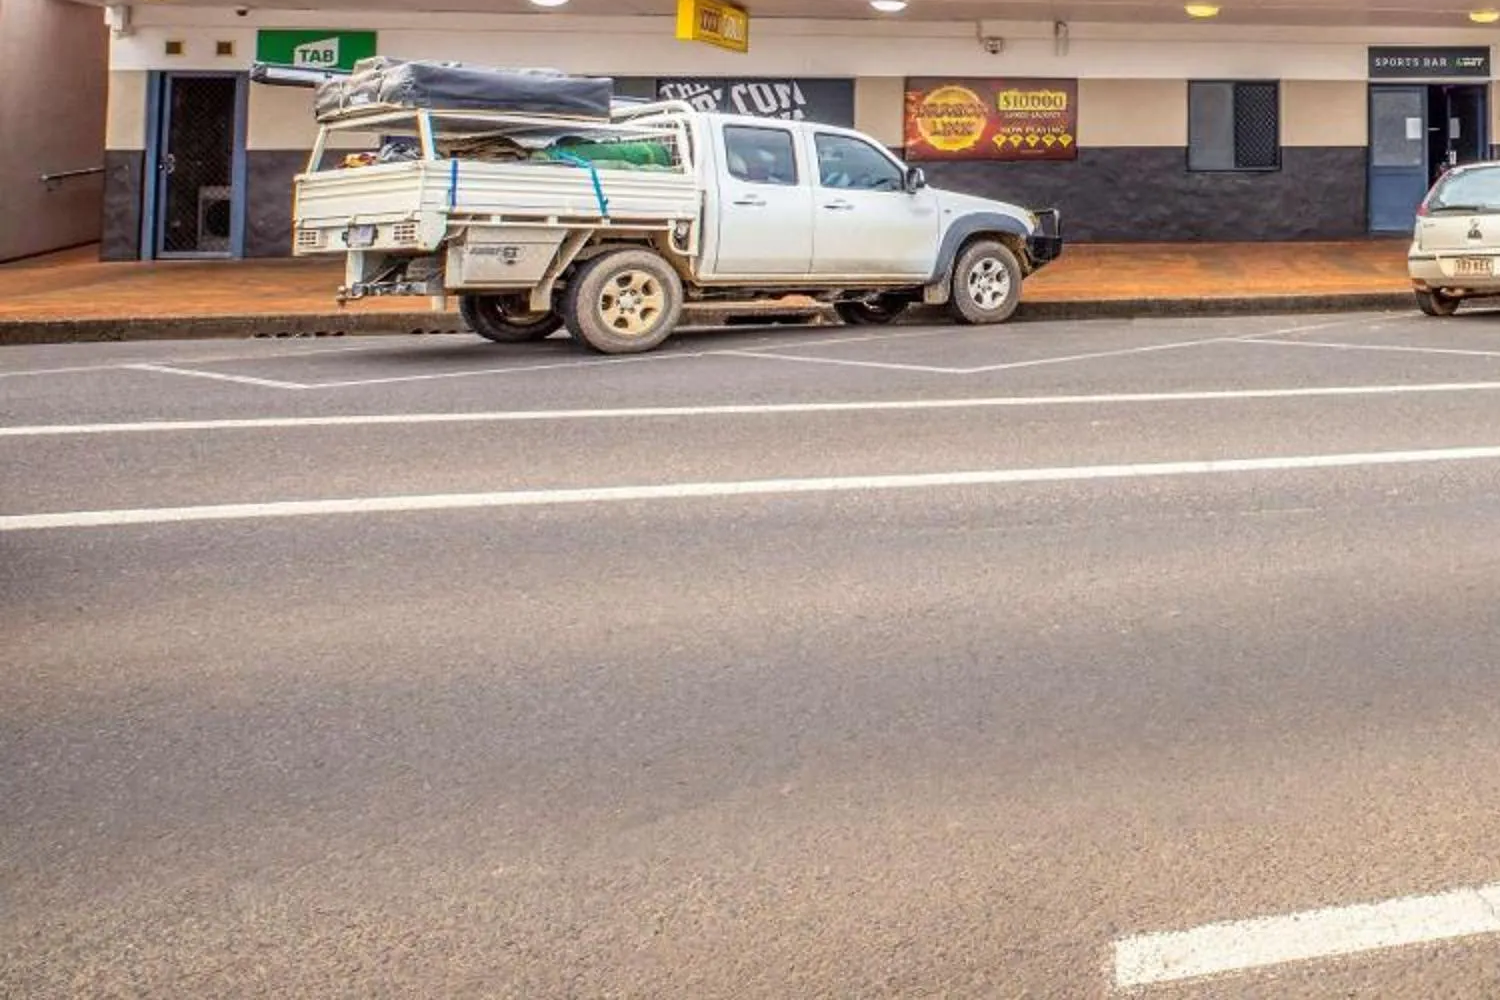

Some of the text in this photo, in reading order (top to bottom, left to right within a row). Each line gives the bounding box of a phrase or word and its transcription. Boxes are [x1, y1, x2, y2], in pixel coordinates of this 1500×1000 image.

[298, 49, 335, 63] TAB
[1375, 57, 1420, 68] SPORTS
[1423, 57, 1448, 68] BAR
